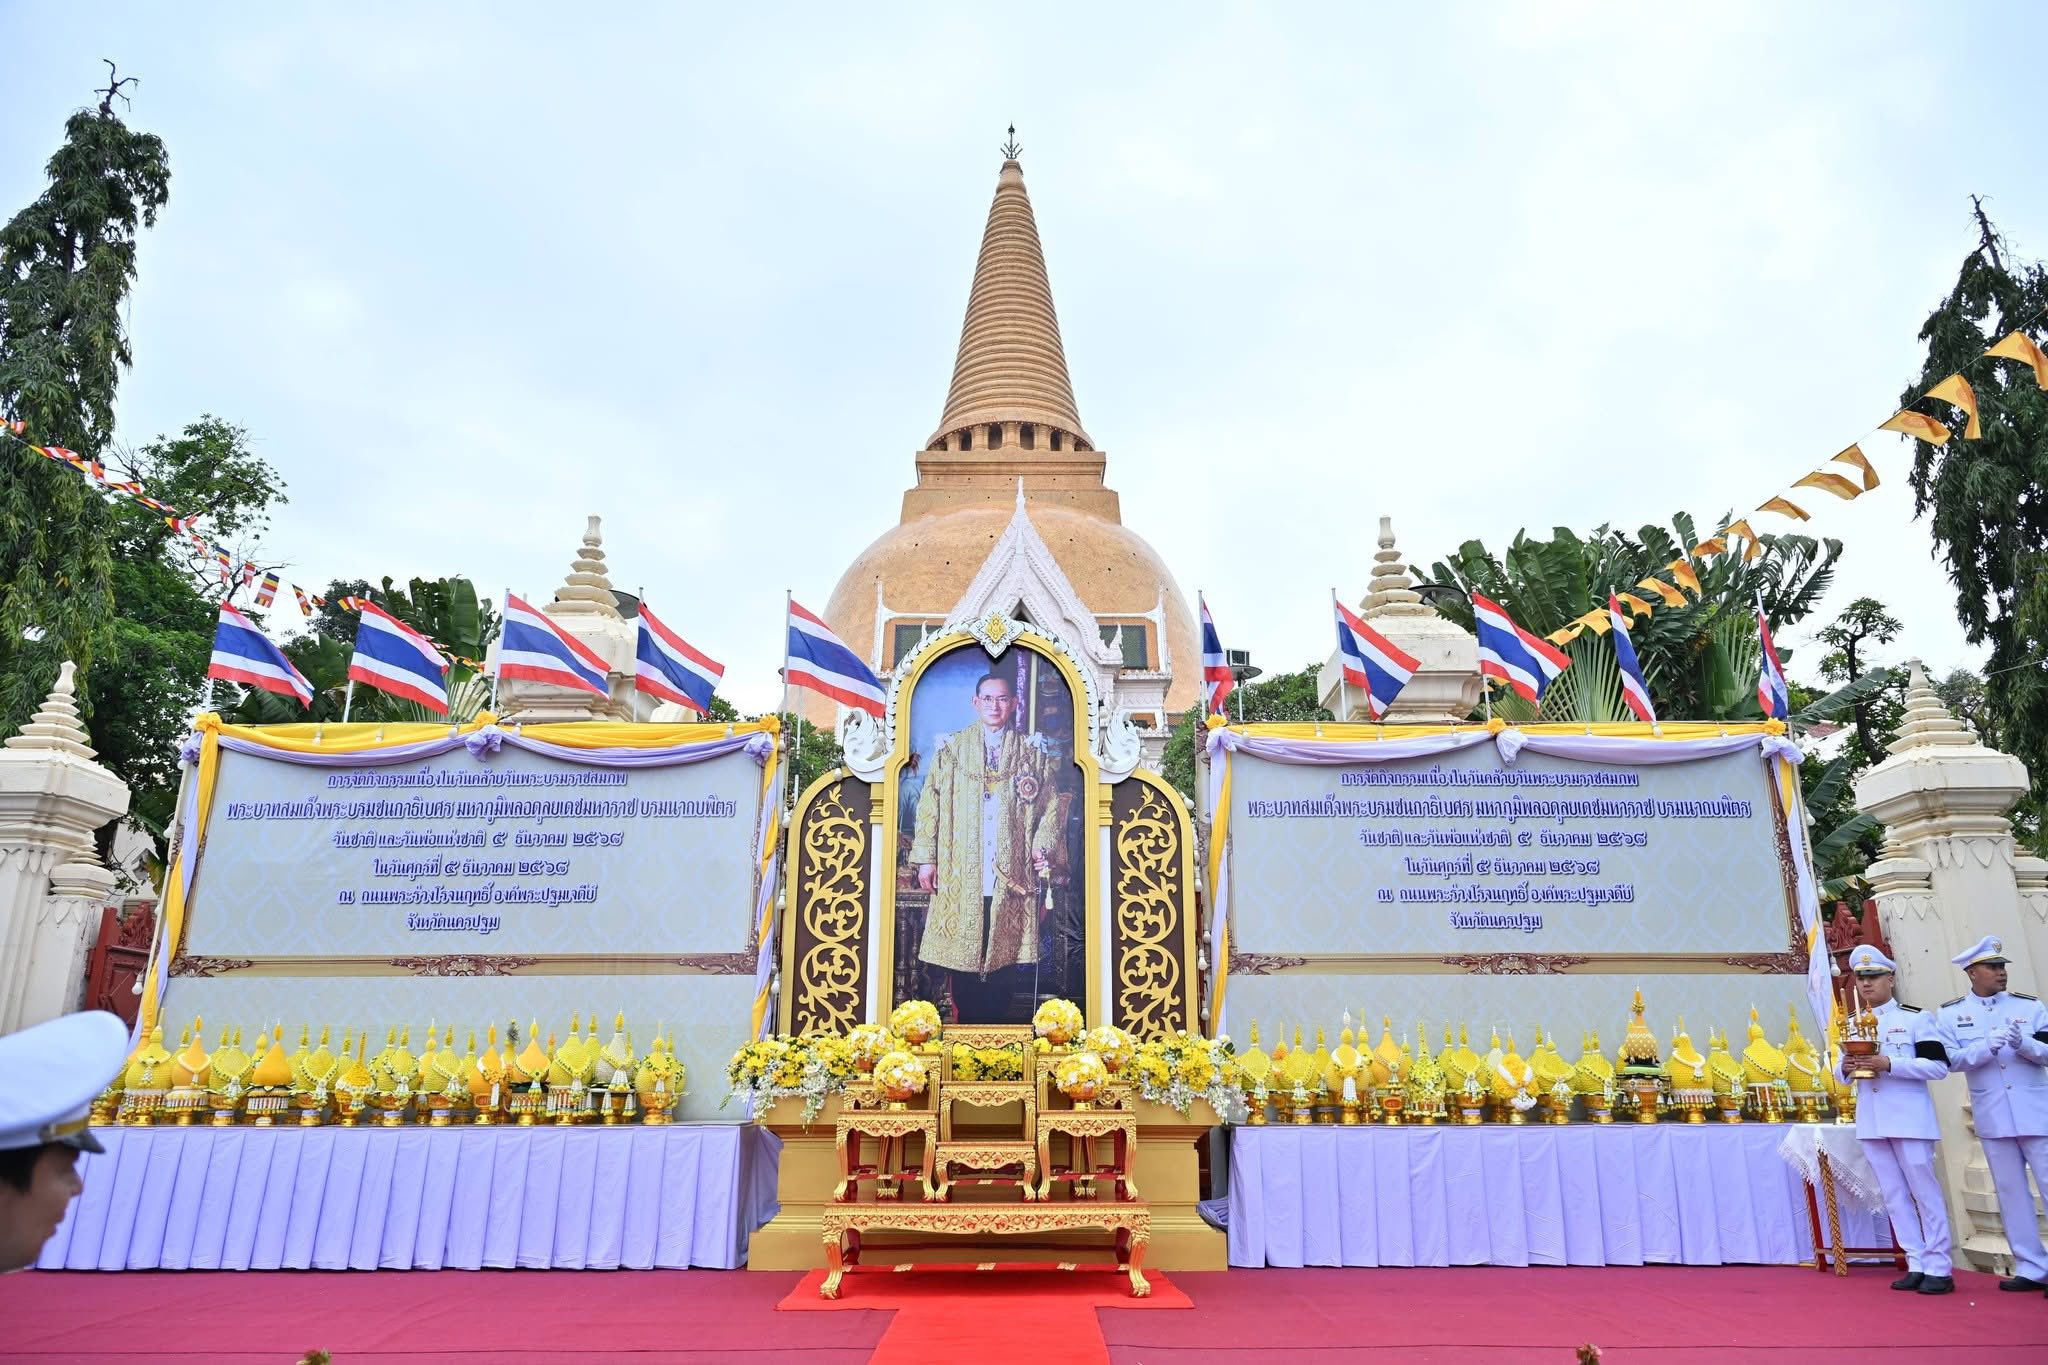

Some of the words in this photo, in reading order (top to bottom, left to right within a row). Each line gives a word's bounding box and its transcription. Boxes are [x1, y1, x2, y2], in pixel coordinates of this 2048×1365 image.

[332, 830, 378, 849] วันชาติ
[378, 829, 487, 849] และวันพ่อแห่งชาติ
[492, 831, 509, 848] ๕
[515, 830, 568, 848] ธันวาคม
[572, 831, 625, 848] ๒๕๖๘
[1360, 828, 1404, 847] วันชาติ
[1404, 828, 1513, 848] และวันพ่อแห่งชาติ
[1517, 831, 1533, 848] ๕
[1540, 829, 1593, 848] ธันวาคม
[1596, 831, 1648, 848] ๒๕๖๘
[374, 854, 443, 882] ในวันศุกร์ที่
[444, 860, 461, 878] ๕
[462, 858, 516, 878] ธันวาคม
[517, 860, 570, 877] ๒๕๖๘
[1404, 852, 1474, 881] ในวันศุกร์ที่
[1476, 859, 1492, 876] ๕
[1493, 857, 1547, 876] ธันวาคม
[1548, 859, 1601, 876] ๒๕๖๘
[339, 890, 356, 906] ณ
[494, 882, 599, 908] องค์พระปฐมเจดีย์
[1378, 889, 1395, 904] ณ
[1531, 884, 1635, 908] องค์พระปฐมเจดีย์
[407, 912, 501, 936] จังหวัดนครปฐม
[1450, 911, 1543, 934] จังหวัดนครปฐม
